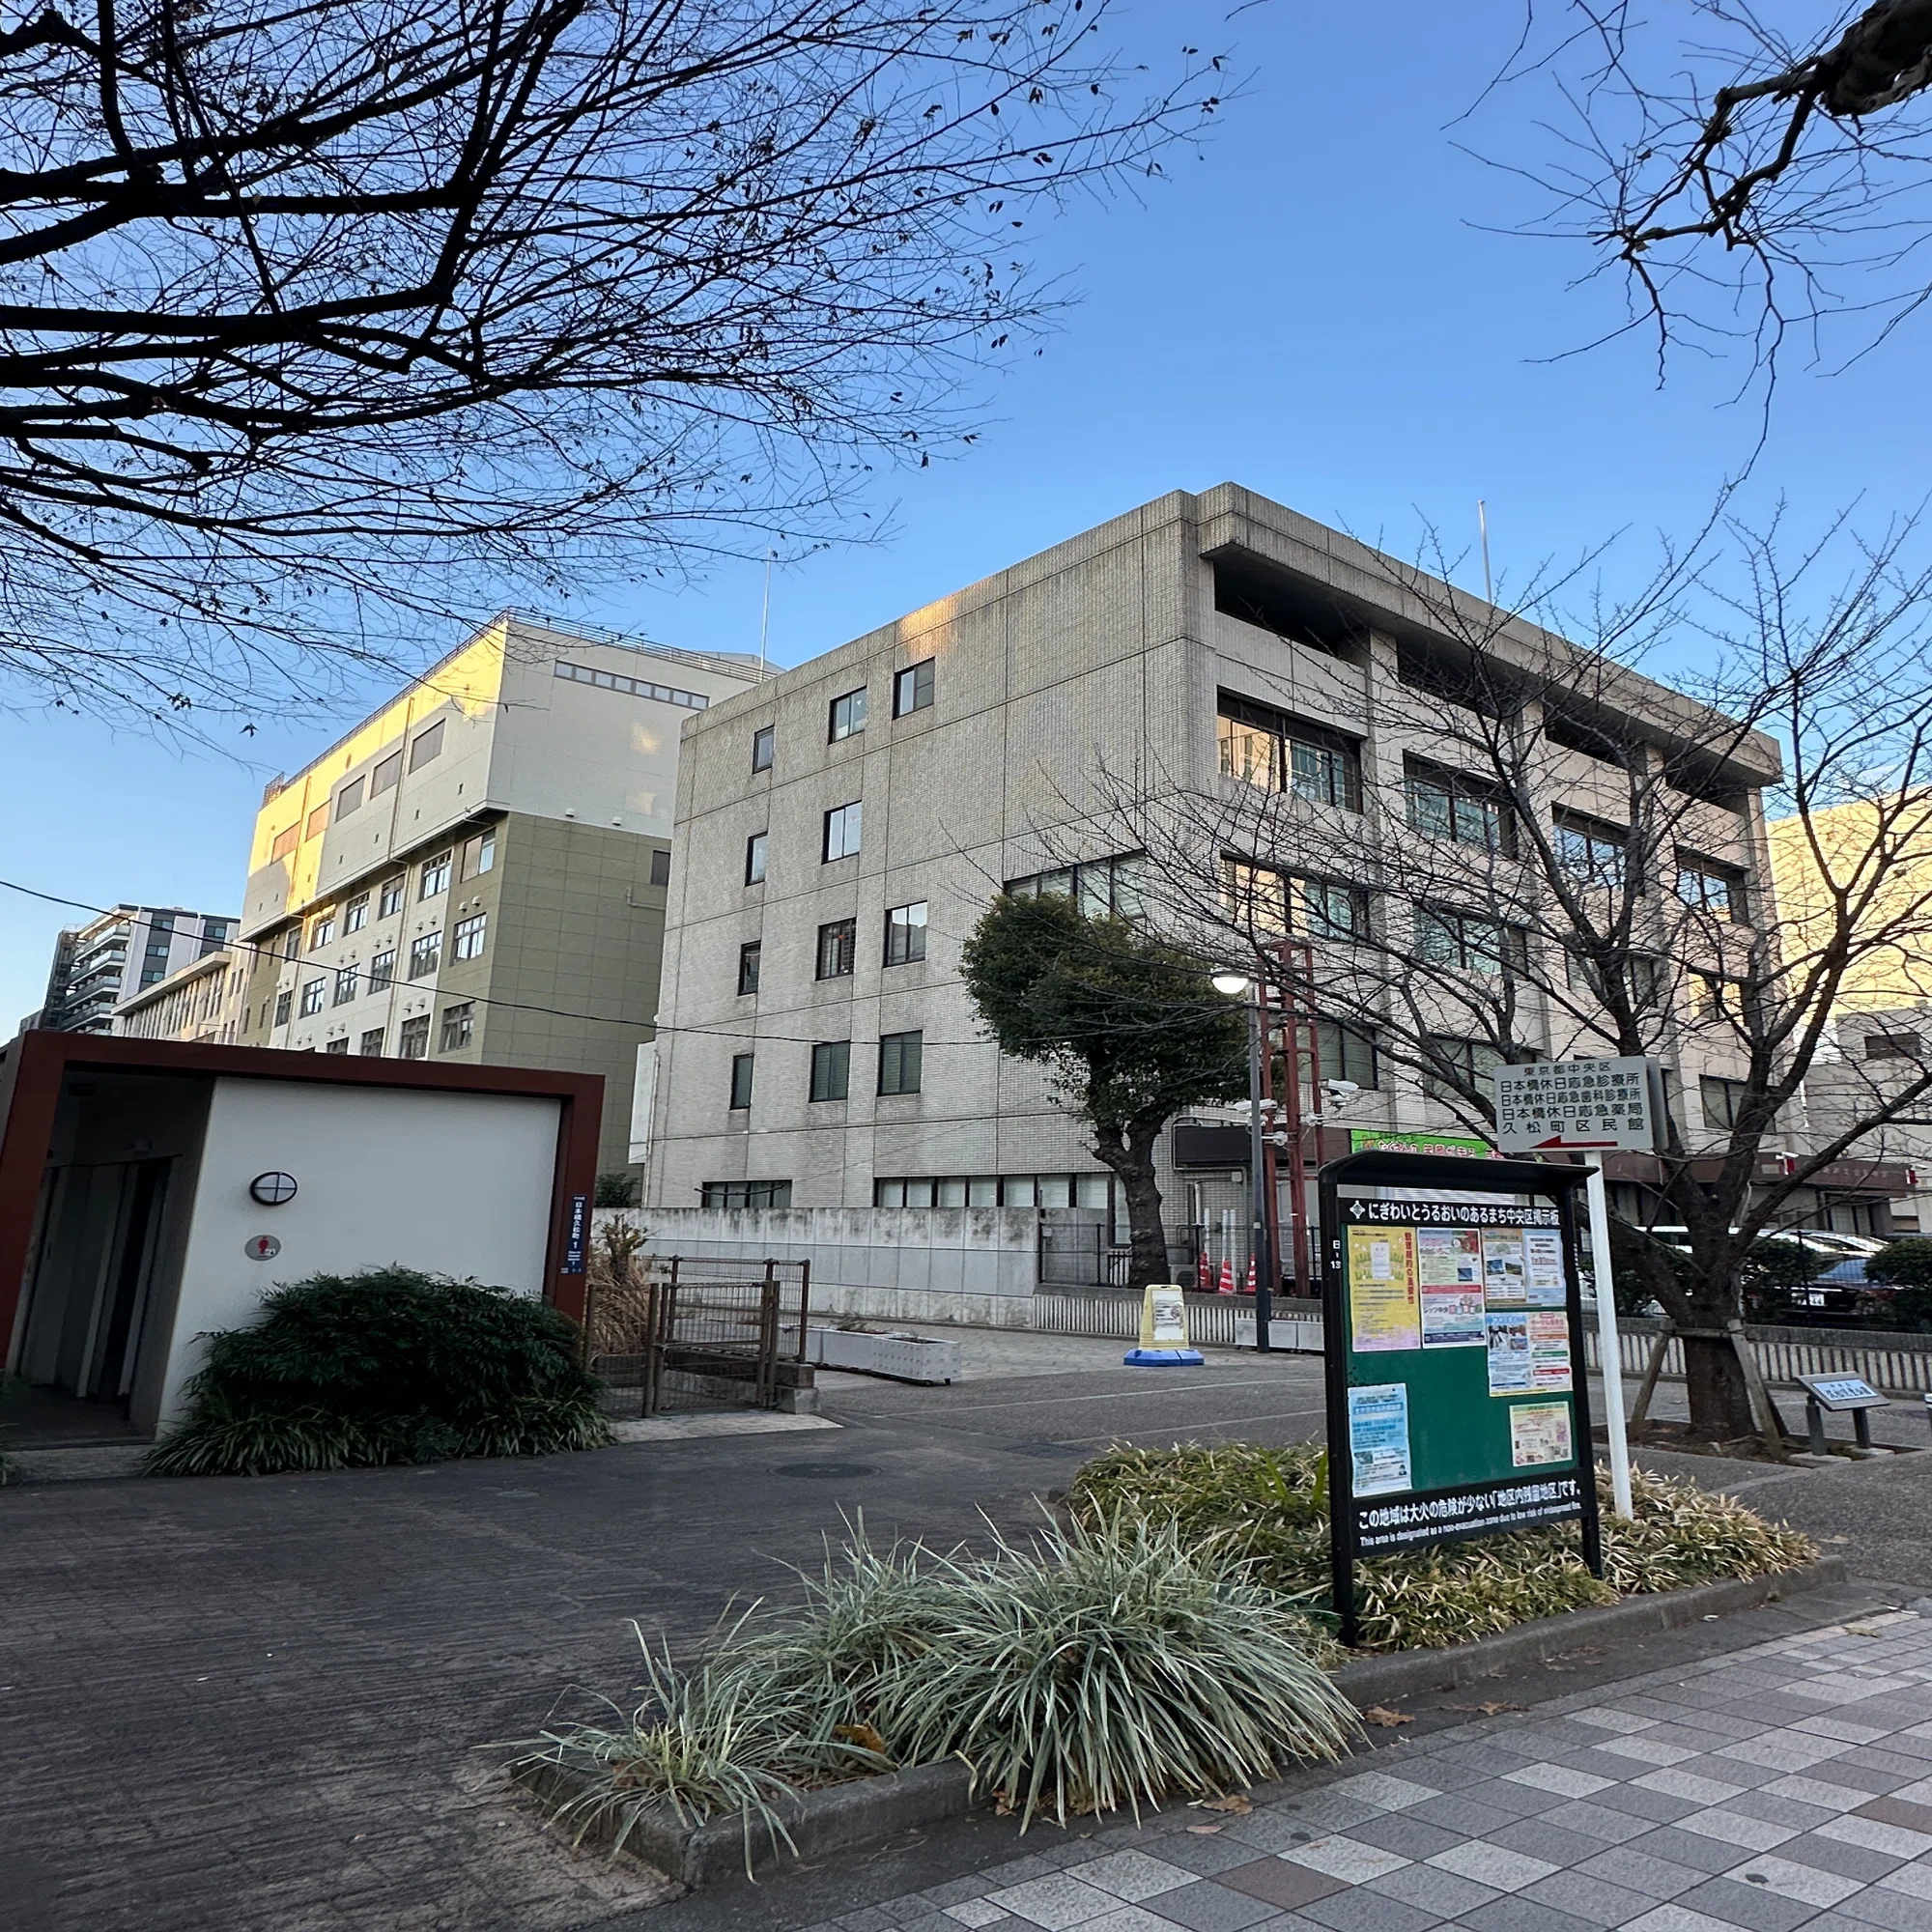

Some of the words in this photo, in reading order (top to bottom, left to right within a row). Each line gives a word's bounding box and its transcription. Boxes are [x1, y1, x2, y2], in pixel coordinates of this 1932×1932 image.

[1524, 1062, 1611, 1076] 東京都中央区
[1500, 1072, 1640, 1093] 日本橋休日応急診療所
[1501, 1088, 1641, 1106] 日本橋休日応急歯科診療所
[1502, 1102, 1643, 1121] 日本橋休日応急薬局
[1502, 1118, 1644, 1135] 久松町区民館
[1368, 1203, 1560, 1226] にぎわいとうるおいのあるまち中央区掲示板
[1359, 1535, 1375, 1547] This
